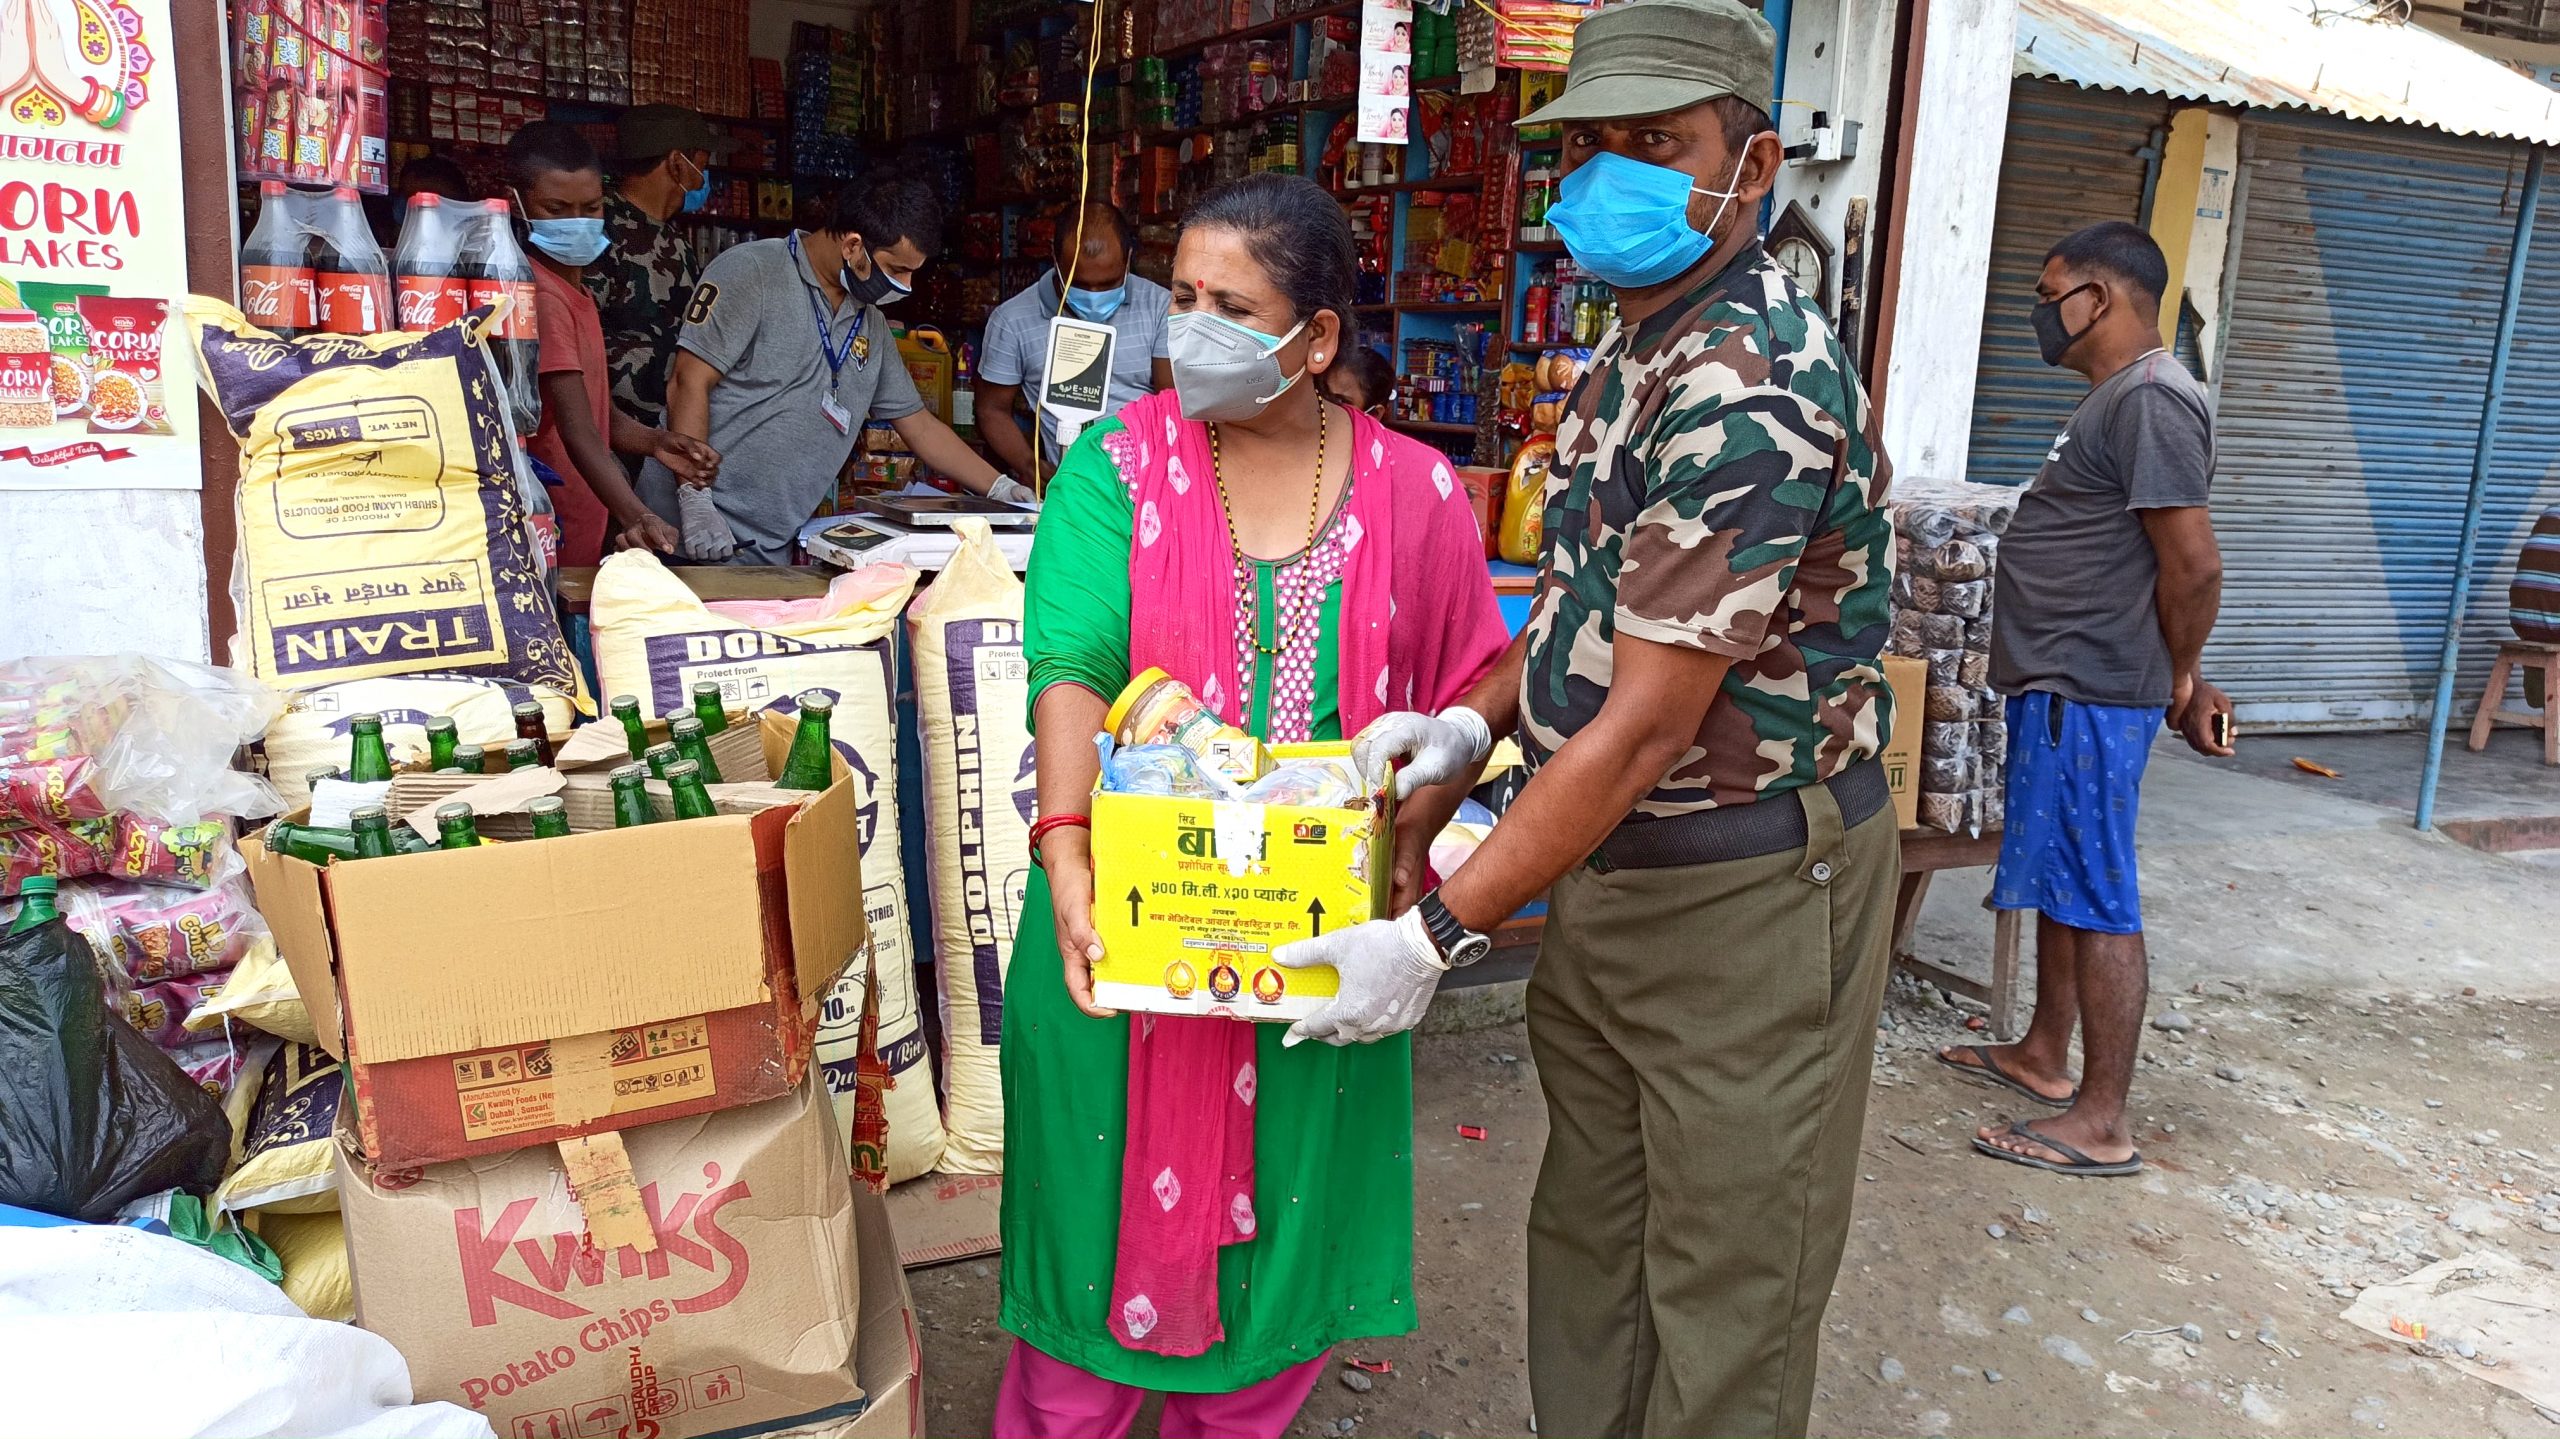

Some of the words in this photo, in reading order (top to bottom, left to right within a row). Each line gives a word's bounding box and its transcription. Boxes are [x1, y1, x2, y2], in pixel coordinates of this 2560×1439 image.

[686, 281, 720, 325] 8
[1072, 385, 1100, 397] E-SUN
[341, 426, 350, 438] 3
[368, 424, 389, 432] WT.
[392, 421, 418, 430] NET.
[301, 427, 337, 442] KGS.
[32, 449, 75, 465] Delightful
[77, 445, 99, 455] Taste
[284, 505, 340, 518] PRODUCTS
[343, 503, 370, 512] FOOD
[405, 500, 438, 509] SHUBH
[342, 513, 390, 523] PRODUCT
[286, 616, 479, 665] TRAIN
[697, 669, 732, 679] Protect
[734, 666, 758, 677] from
[47, 767, 73, 820] KRAZY
[955, 714, 996, 946] DOLPHIN
[838, 982, 851, 994] WT.
[823, 997, 845, 1022] 10
[846, 1006, 855, 1014] KG
[463, 1088, 511, 1102] Manufactured
[488, 1098, 514, 1109] Kwality
[516, 1095, 537, 1105] Foods
[460, 1346, 576, 1409] Potato
[580, 1299, 670, 1352] Chips
[645, 1365, 660, 1417] GROUP
